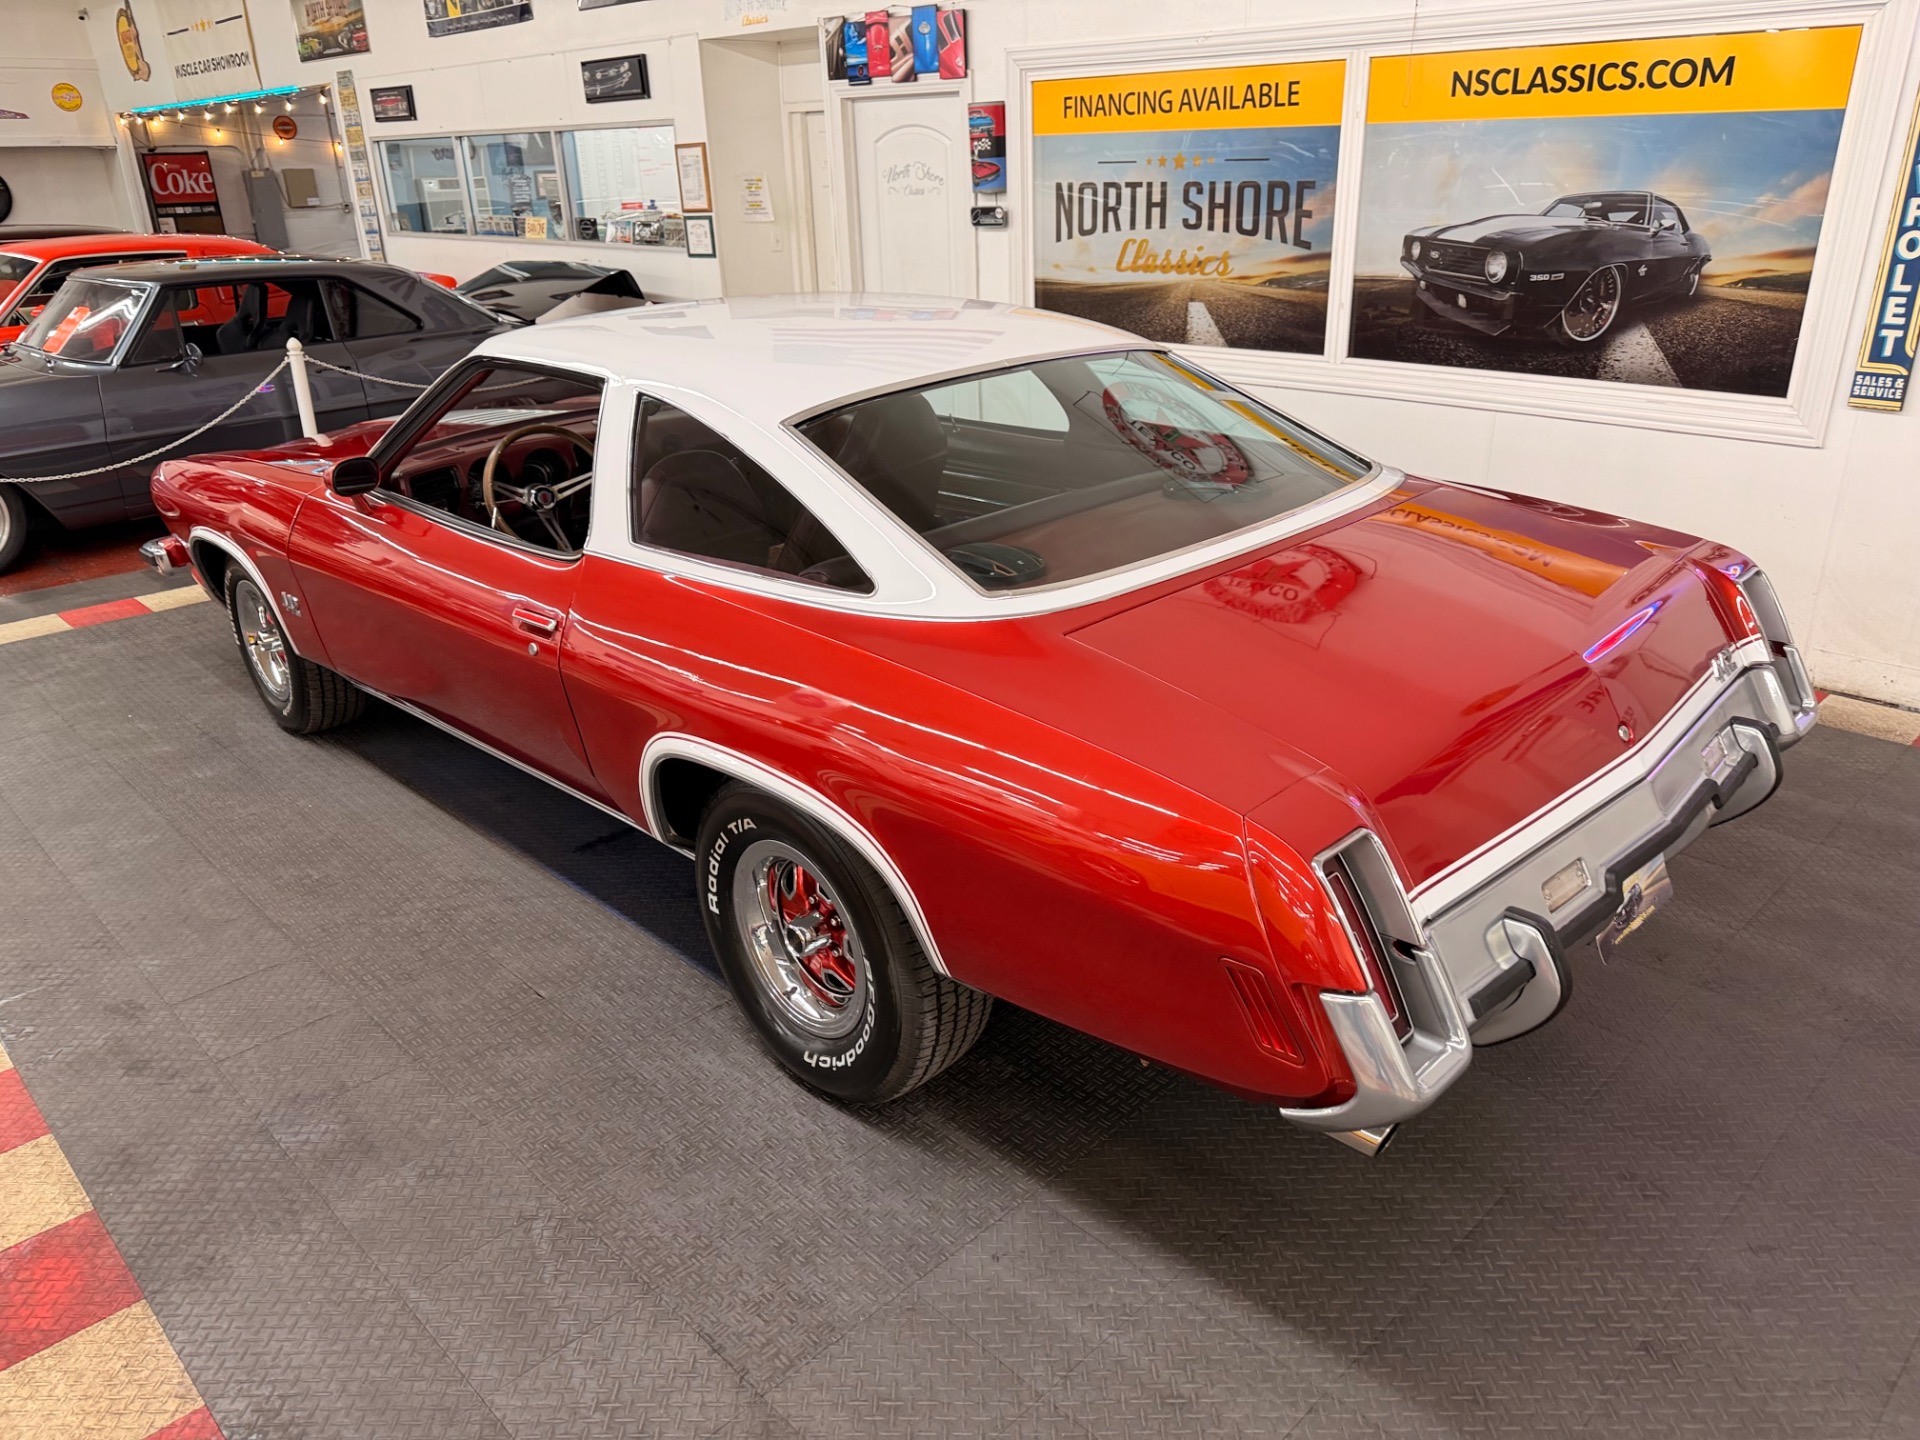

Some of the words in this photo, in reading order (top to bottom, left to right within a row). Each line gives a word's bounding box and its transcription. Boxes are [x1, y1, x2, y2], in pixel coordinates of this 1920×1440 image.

[174, 61, 199, 79] MUSCLE
[198, 58, 212, 74] CAR
[211, 50, 251, 72] SHOWROOM
[1451, 56, 1736, 98] NSCLASSICS.COM
[1063, 89, 1173, 119] FINANCING
[1178, 80, 1300, 113] AVAILABLE
[149, 163, 214, 195] Coke
[882, 164, 911, 184] North
[913, 161, 944, 185] Shore
[1055, 181, 1168, 243] NORTH
[1181, 180, 1316, 251] SHORE
[1115, 238, 1235, 277] Classics
[1879, 163, 1920, 358] ROLET
[1529, 274, 1550, 282] 350
[1852, 385, 1904, 400] SERVICE
[1855, 374, 1893, 388] SALES
[1894, 378, 1905, 389] &
[708, 832, 730, 915] Radial
[727, 818, 758, 835] T/A
